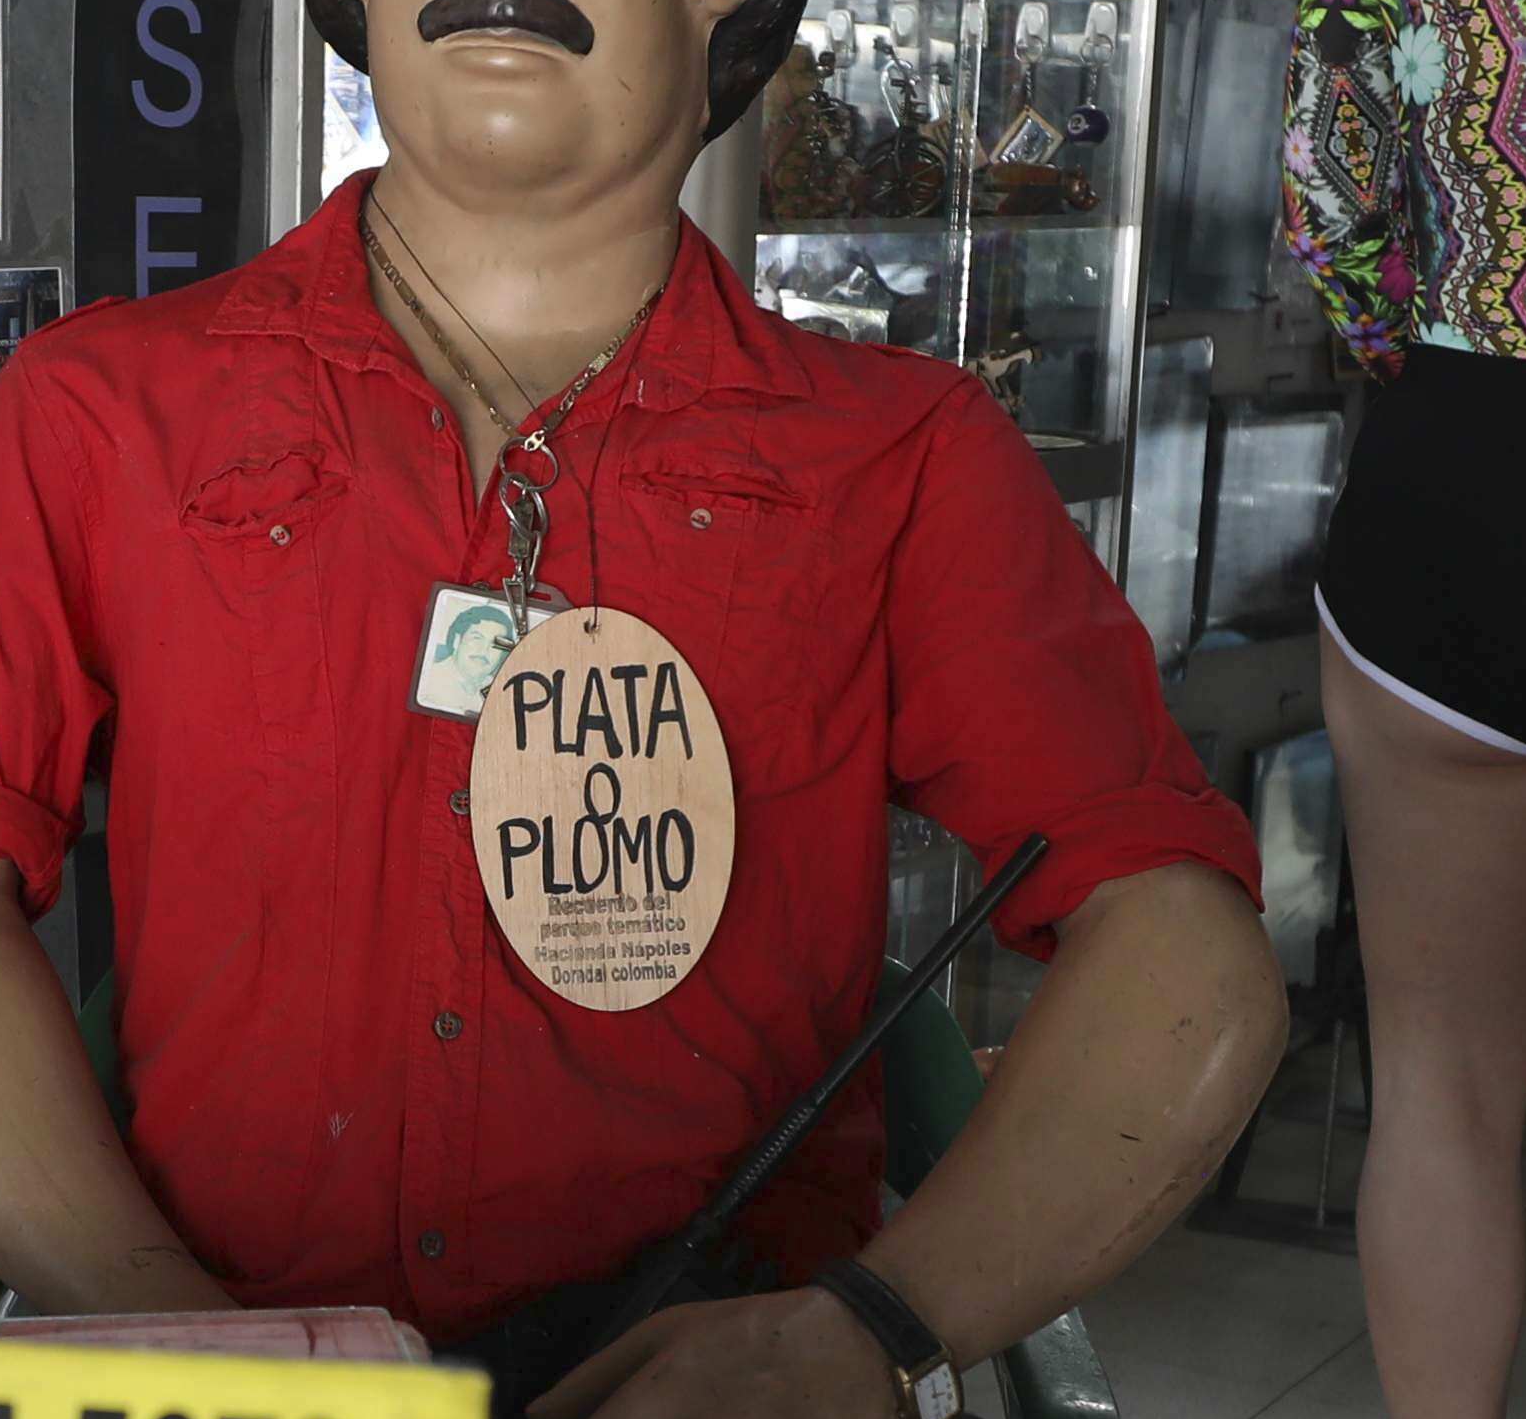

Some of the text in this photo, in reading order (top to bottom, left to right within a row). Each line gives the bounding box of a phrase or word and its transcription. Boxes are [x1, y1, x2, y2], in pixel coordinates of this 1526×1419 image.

[502, 661, 694, 760] PLATA
[583, 761, 622, 826] O
[496, 808, 695, 900] PLOMO
[547, 892, 672, 917] Recuerdo del
[535, 941, 616, 963] Hacienda
[551, 962, 677, 985] Doradal colombia
